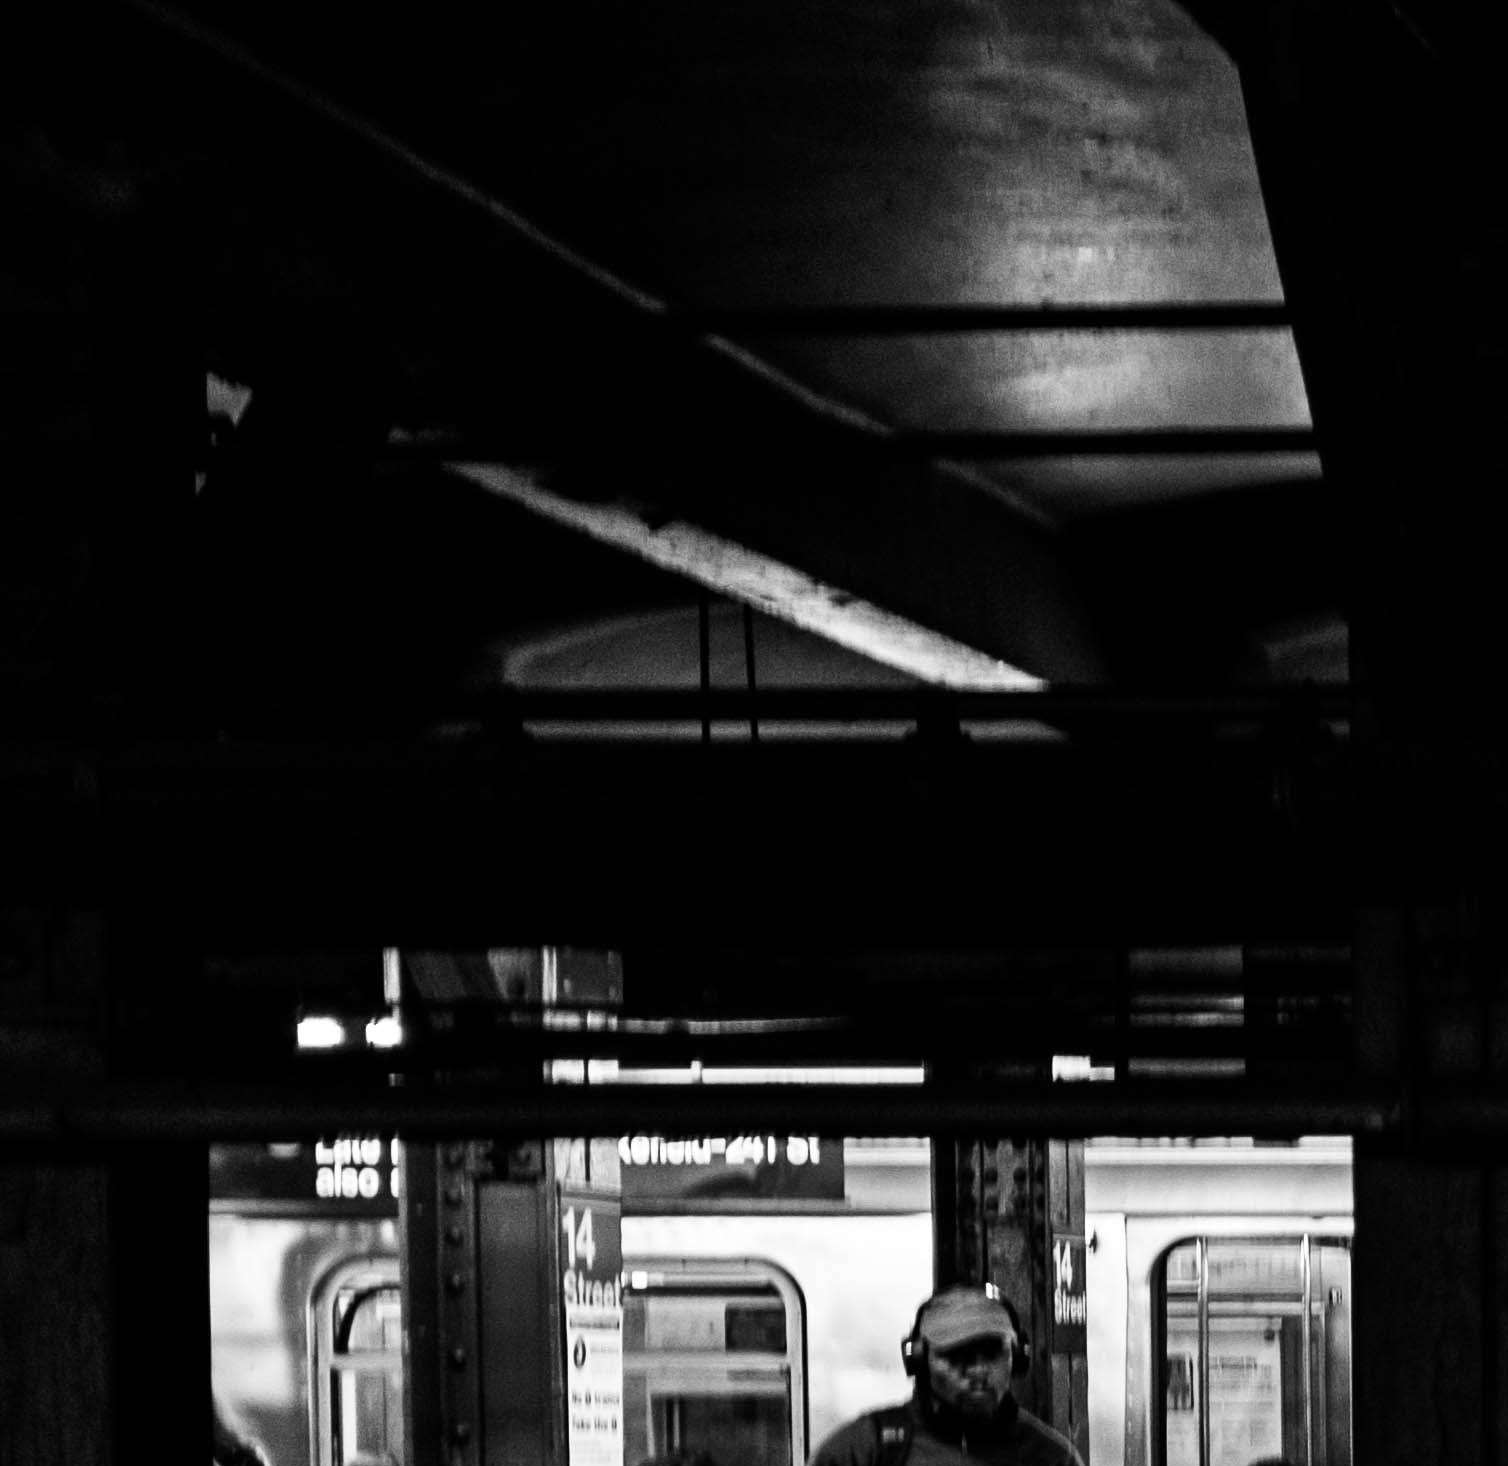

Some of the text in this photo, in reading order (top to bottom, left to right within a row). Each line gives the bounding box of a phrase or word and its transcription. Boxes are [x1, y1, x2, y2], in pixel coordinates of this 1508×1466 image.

[315, 1166, 380, 1198] also
[562, 1205, 596, 1270] 14
[1053, 1240, 1073, 1290] 14
[564, 1268, 621, 1305] Street
[1055, 1288, 1086, 1325] Street
